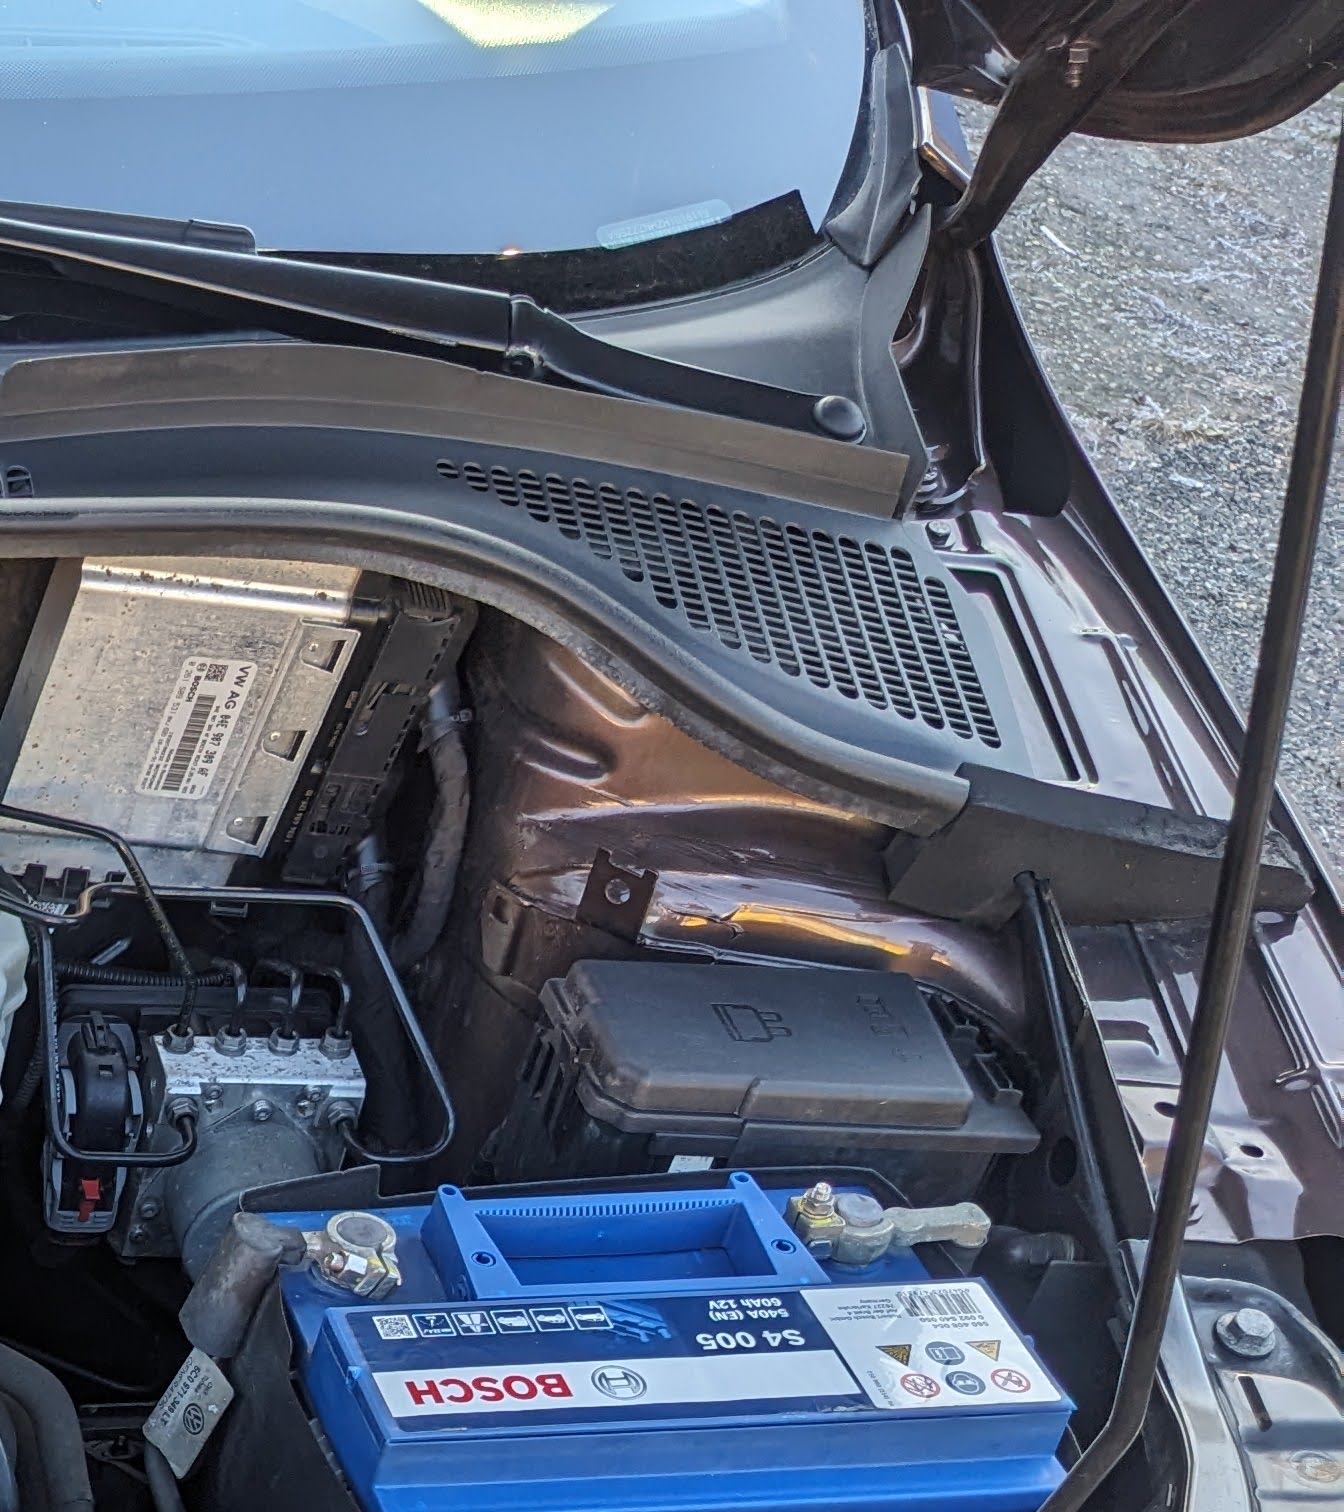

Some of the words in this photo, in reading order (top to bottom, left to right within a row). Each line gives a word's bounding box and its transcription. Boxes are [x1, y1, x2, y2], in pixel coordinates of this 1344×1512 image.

[232, 664, 251, 687] VW
[184, 675, 201, 702] BOSCH
[223, 690, 240, 710] AG
[702, 1298, 742, 1310] 12V
[737, 1295, 785, 1308] 60Ah
[704, 1308, 747, 1321] (EN)
[741, 1306, 792, 1320] 540A
[690, 1329, 760, 1350] 005
[756, 1327, 809, 1346] S4
[401, 1372, 575, 1405] BOSCH
